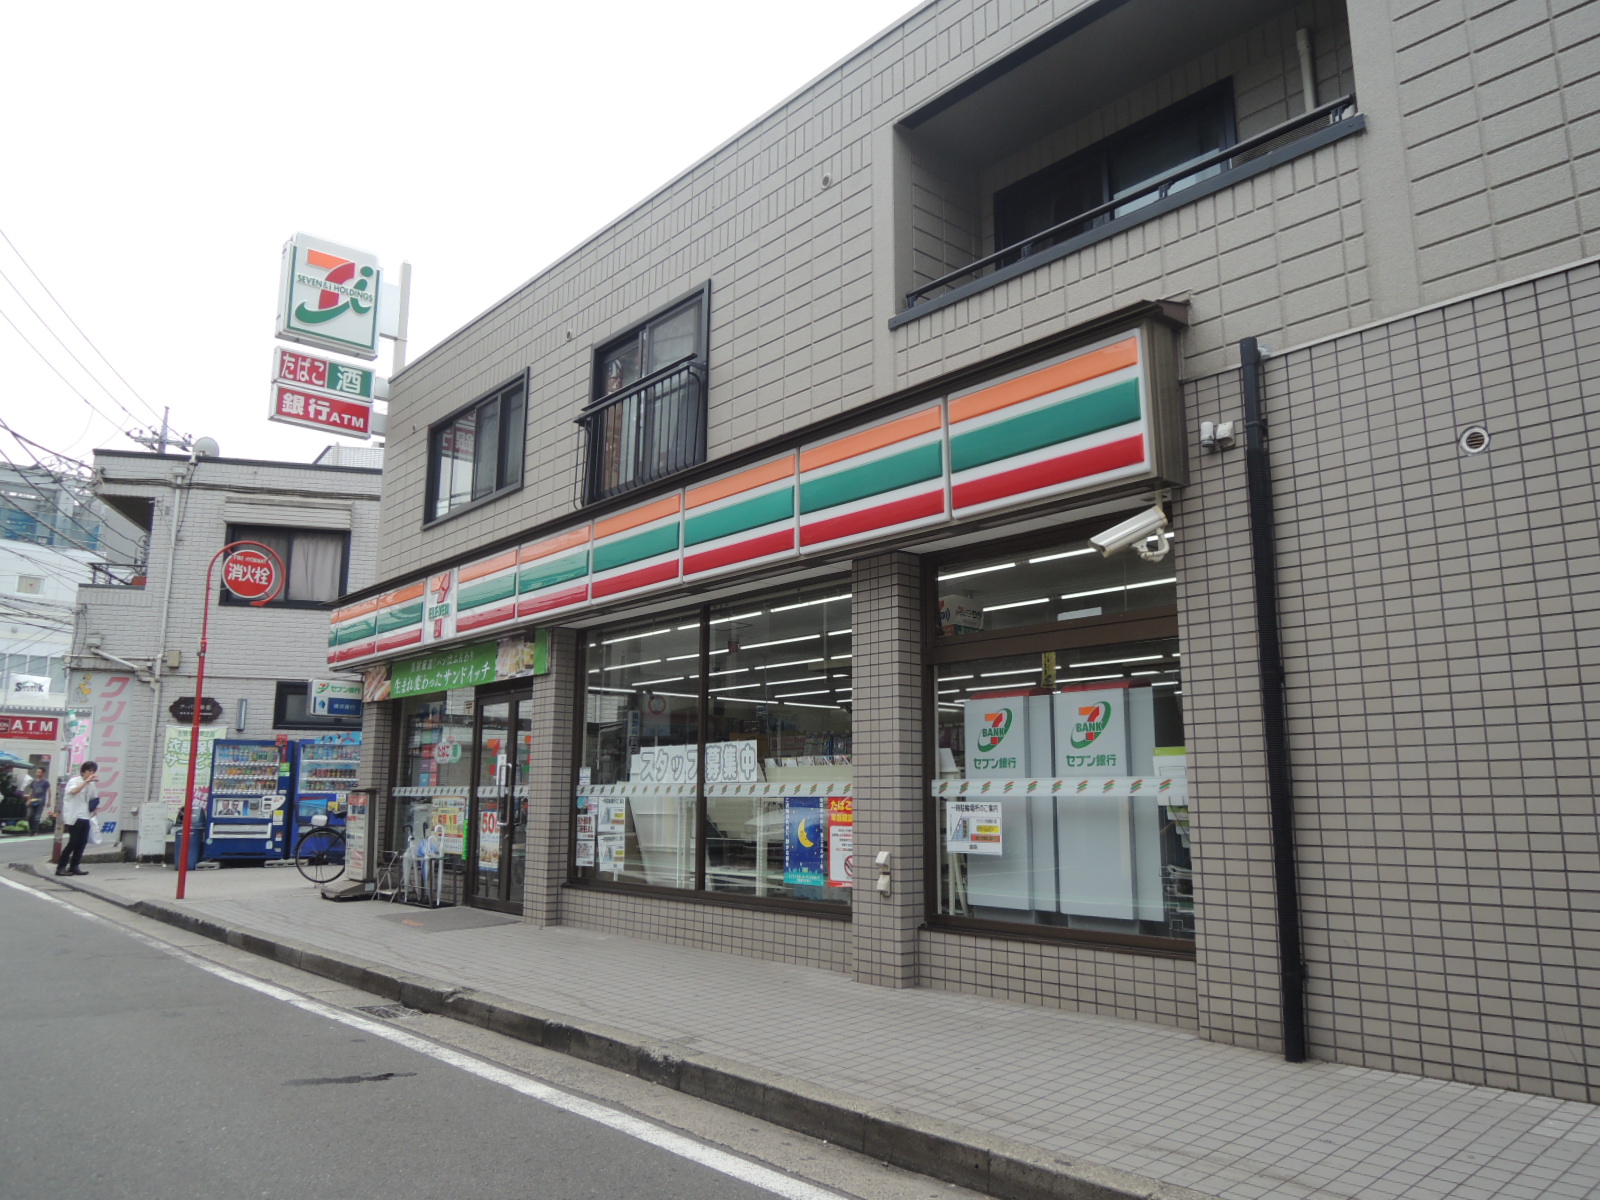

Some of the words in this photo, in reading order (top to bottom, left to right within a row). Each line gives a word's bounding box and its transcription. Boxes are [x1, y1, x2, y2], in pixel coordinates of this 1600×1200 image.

[333, 284, 374, 302] HOLDINGS
[281, 352, 326, 386] たばこ
[336, 365, 362, 394] 酒
[227, 563, 271, 585] 消火栓
[394, 660, 491, 694] 生まれ変わったサンドイッチ
[331, 685, 361, 694] セブン銀行
[11, 719, 53, 732] ATM
[982, 726, 1006, 738] BANK
[1075, 722, 1103, 733] BANK
[973, 757, 1017, 770] セブン銀行
[1066, 754, 1117, 767] セブン銀行
